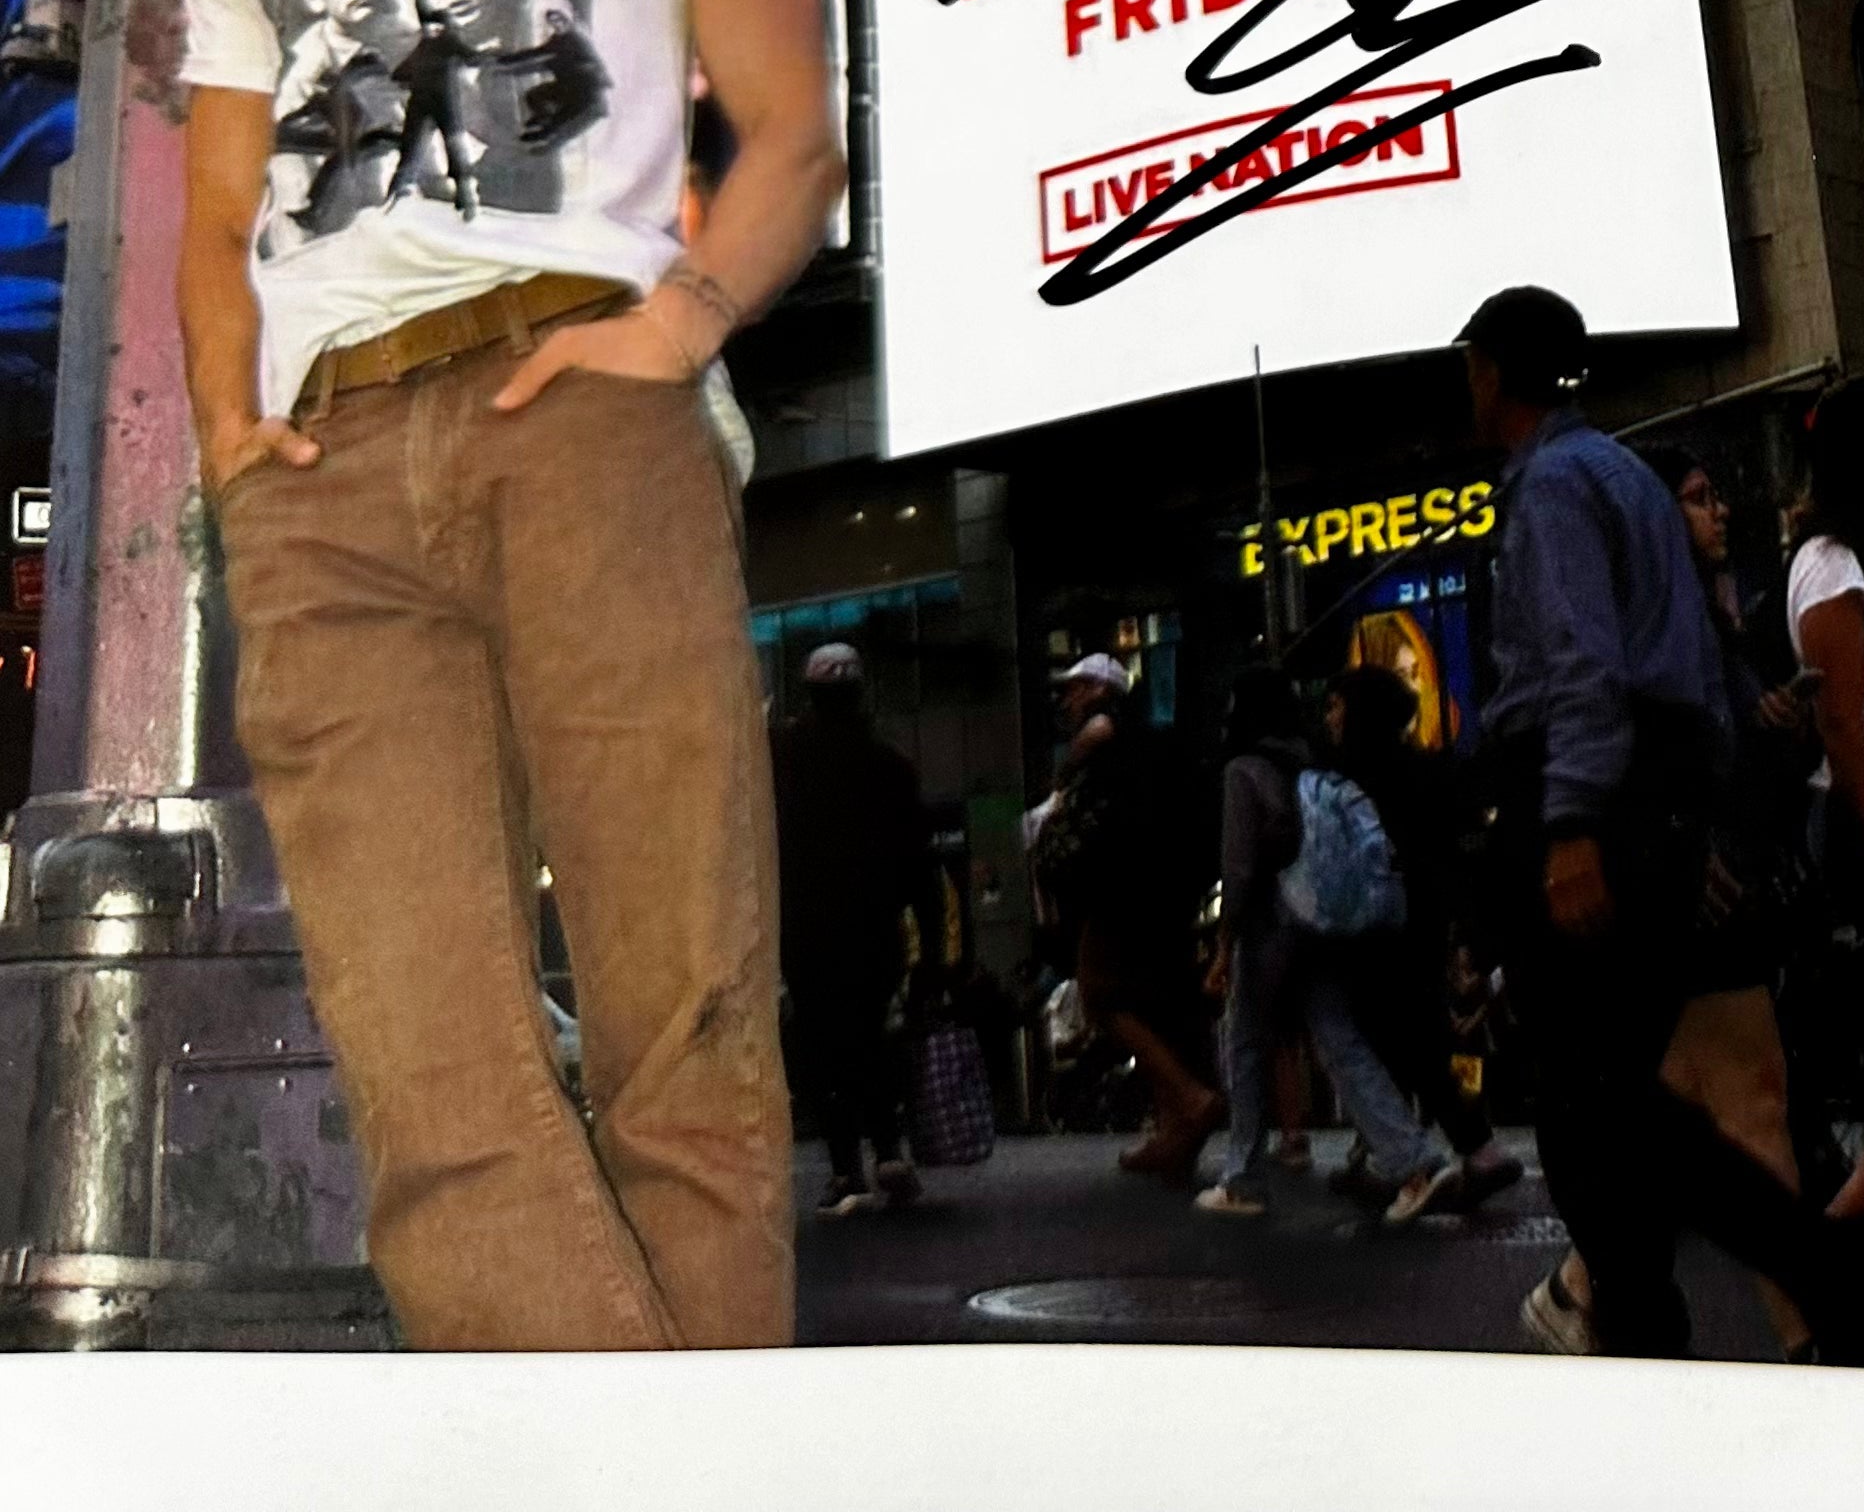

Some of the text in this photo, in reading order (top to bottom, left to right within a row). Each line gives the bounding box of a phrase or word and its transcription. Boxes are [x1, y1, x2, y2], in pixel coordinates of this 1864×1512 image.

[1062, 115, 1425, 233] LIVE NATION
[1239, 480, 1497, 578] EXPRESS
